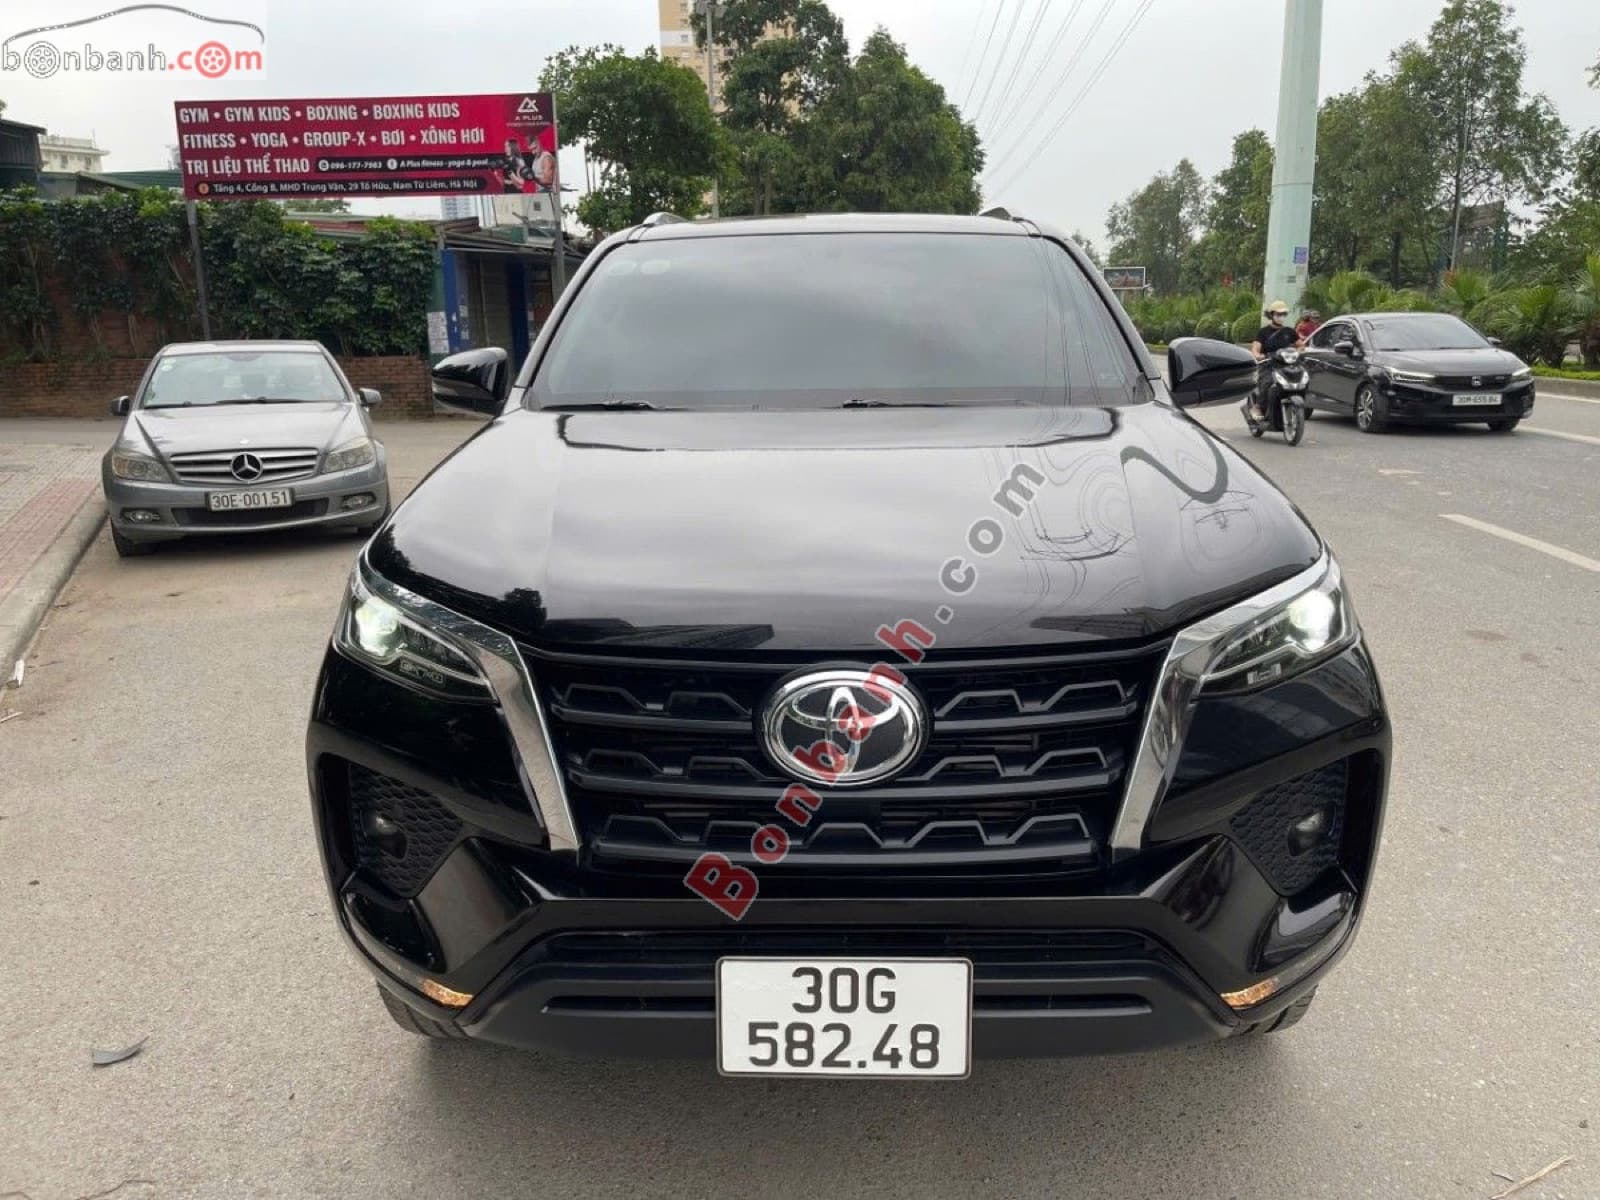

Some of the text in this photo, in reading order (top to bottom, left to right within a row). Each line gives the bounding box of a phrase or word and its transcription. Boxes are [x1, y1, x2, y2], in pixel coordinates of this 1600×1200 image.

[180, 102, 460, 123] GYM GYM KIDS BOXING BOXING KIDS
[183, 133, 236, 149] FITNESS
[251, 132, 288, 148] YOGA
[303, 131, 366, 147] GROUP-X
[420, 124, 457, 145] XÔNG
[460, 127, 485, 144] HƠI
[185, 152, 310, 178] TRỊ LIỆU THỂ THAO
[407, 159, 420, 167] Plus
[302, 182, 327, 193] Trung
[393, 181, 412, 190] Nam
[792, 967, 896, 1013] 30G
[748, 1022, 940, 1069] 582.48
